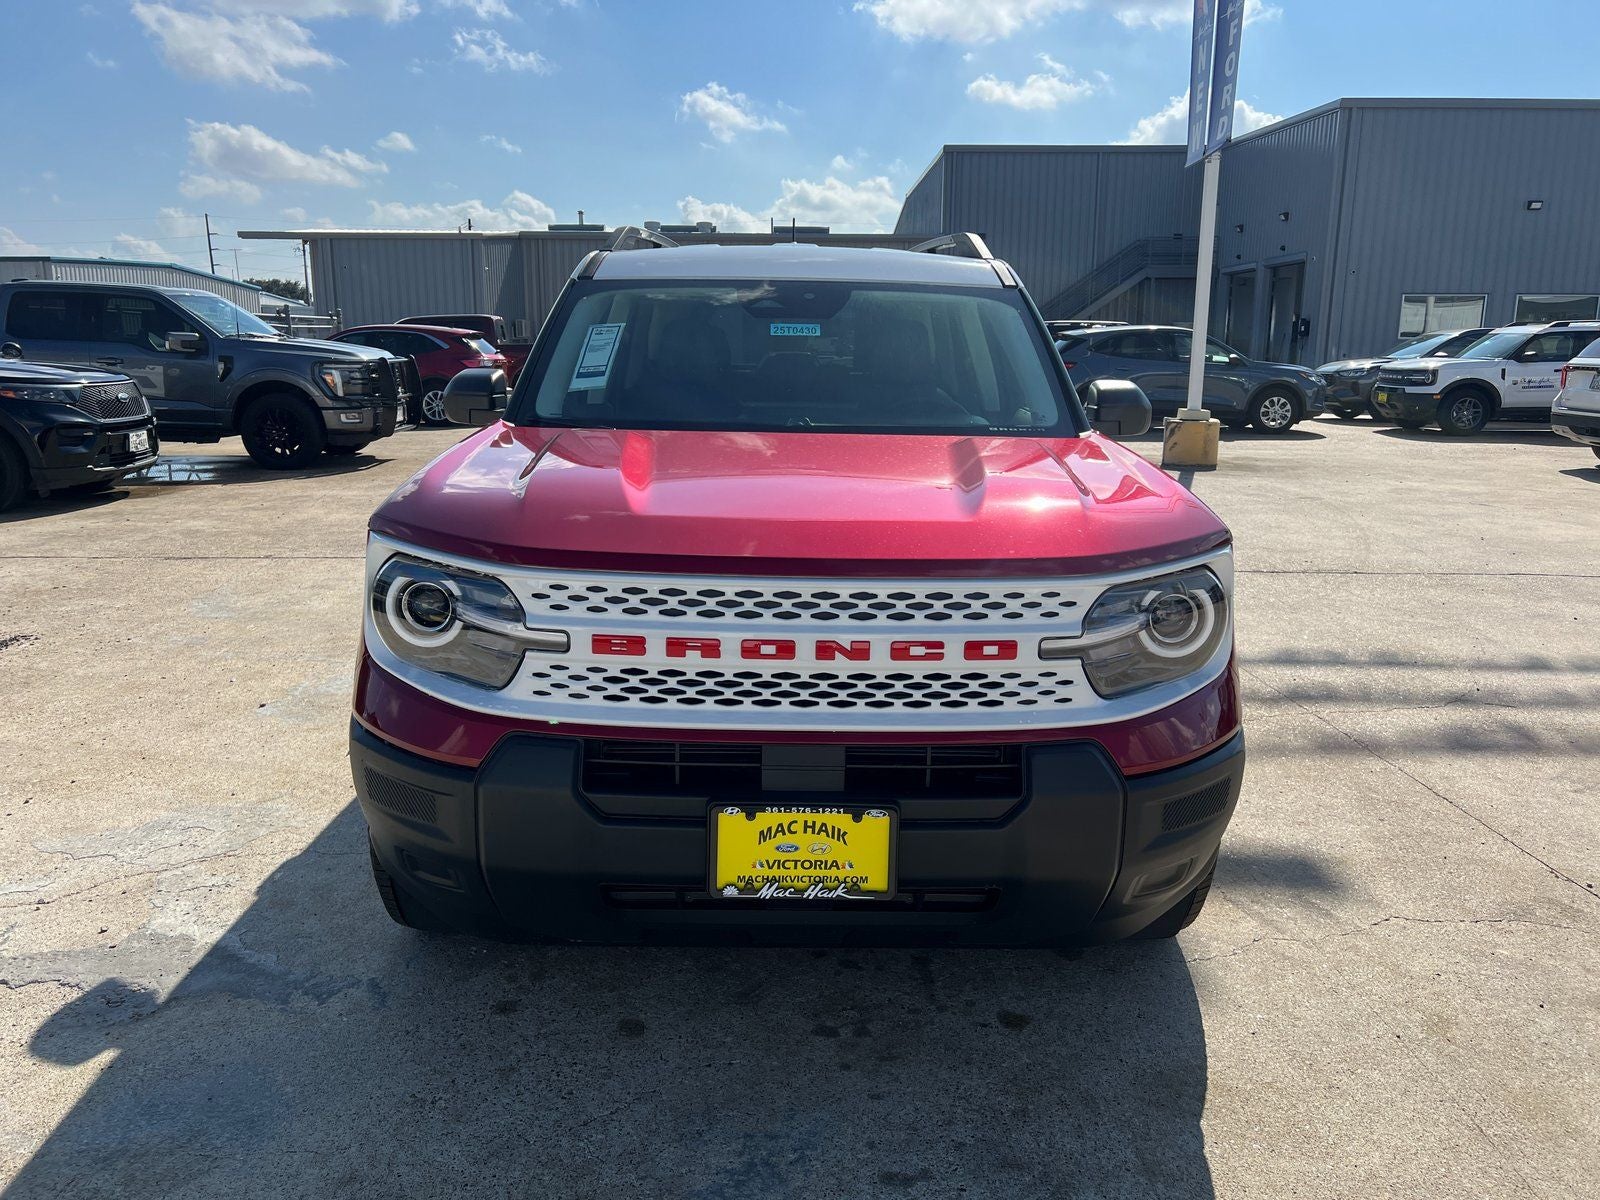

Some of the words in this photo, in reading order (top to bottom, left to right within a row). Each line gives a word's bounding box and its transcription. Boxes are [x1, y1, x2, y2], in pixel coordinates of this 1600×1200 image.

[1216, 18, 1238, 141] FORD
[1191, 40, 1208, 153] NEW
[773, 326, 817, 335] 25T0430
[591, 633, 1018, 661] BRONCO
[765, 806, 844, 814] 361-576-1221
[757, 820, 798, 845] MAC
[803, 820, 848, 846] HAIK
[776, 844, 797, 853] Ford
[765, 859, 841, 870] VICTORIA
[736, 875, 868, 884] MACHAIKVICTORIA.COM
[756, 882, 798, 899] Mac
[802, 882, 851, 899] Haik
